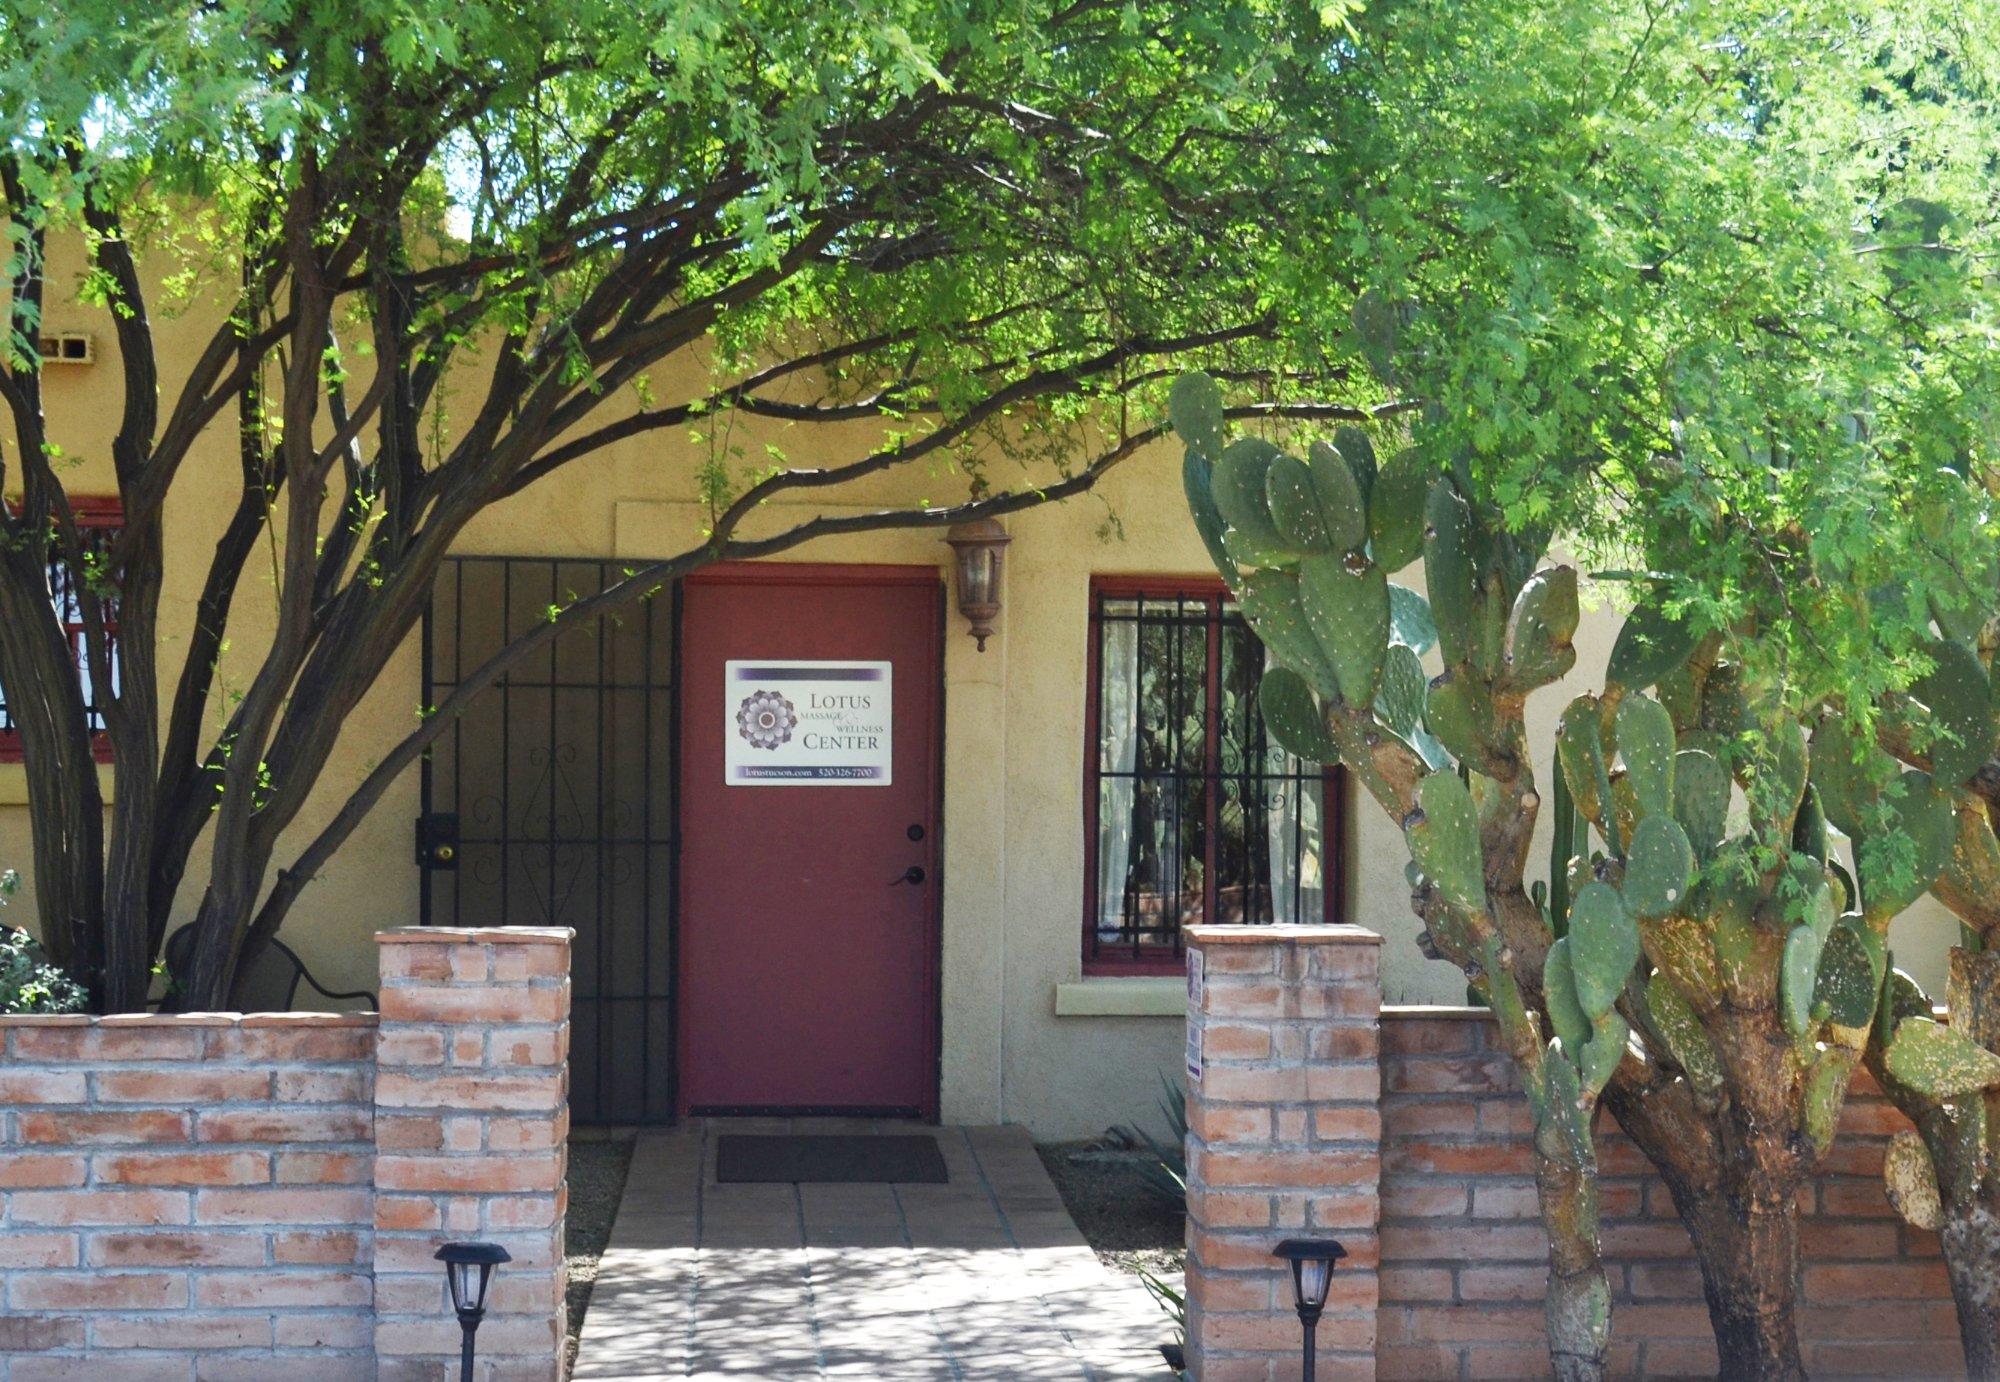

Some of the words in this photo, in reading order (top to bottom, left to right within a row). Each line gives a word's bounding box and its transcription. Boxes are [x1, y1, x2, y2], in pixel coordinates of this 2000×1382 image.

[810, 693, 872, 709] LOTUS
[800, 711, 843, 721] MASSAGE
[836, 724, 884, 734] WELLNESS
[803, 732, 880, 750] CENTER
